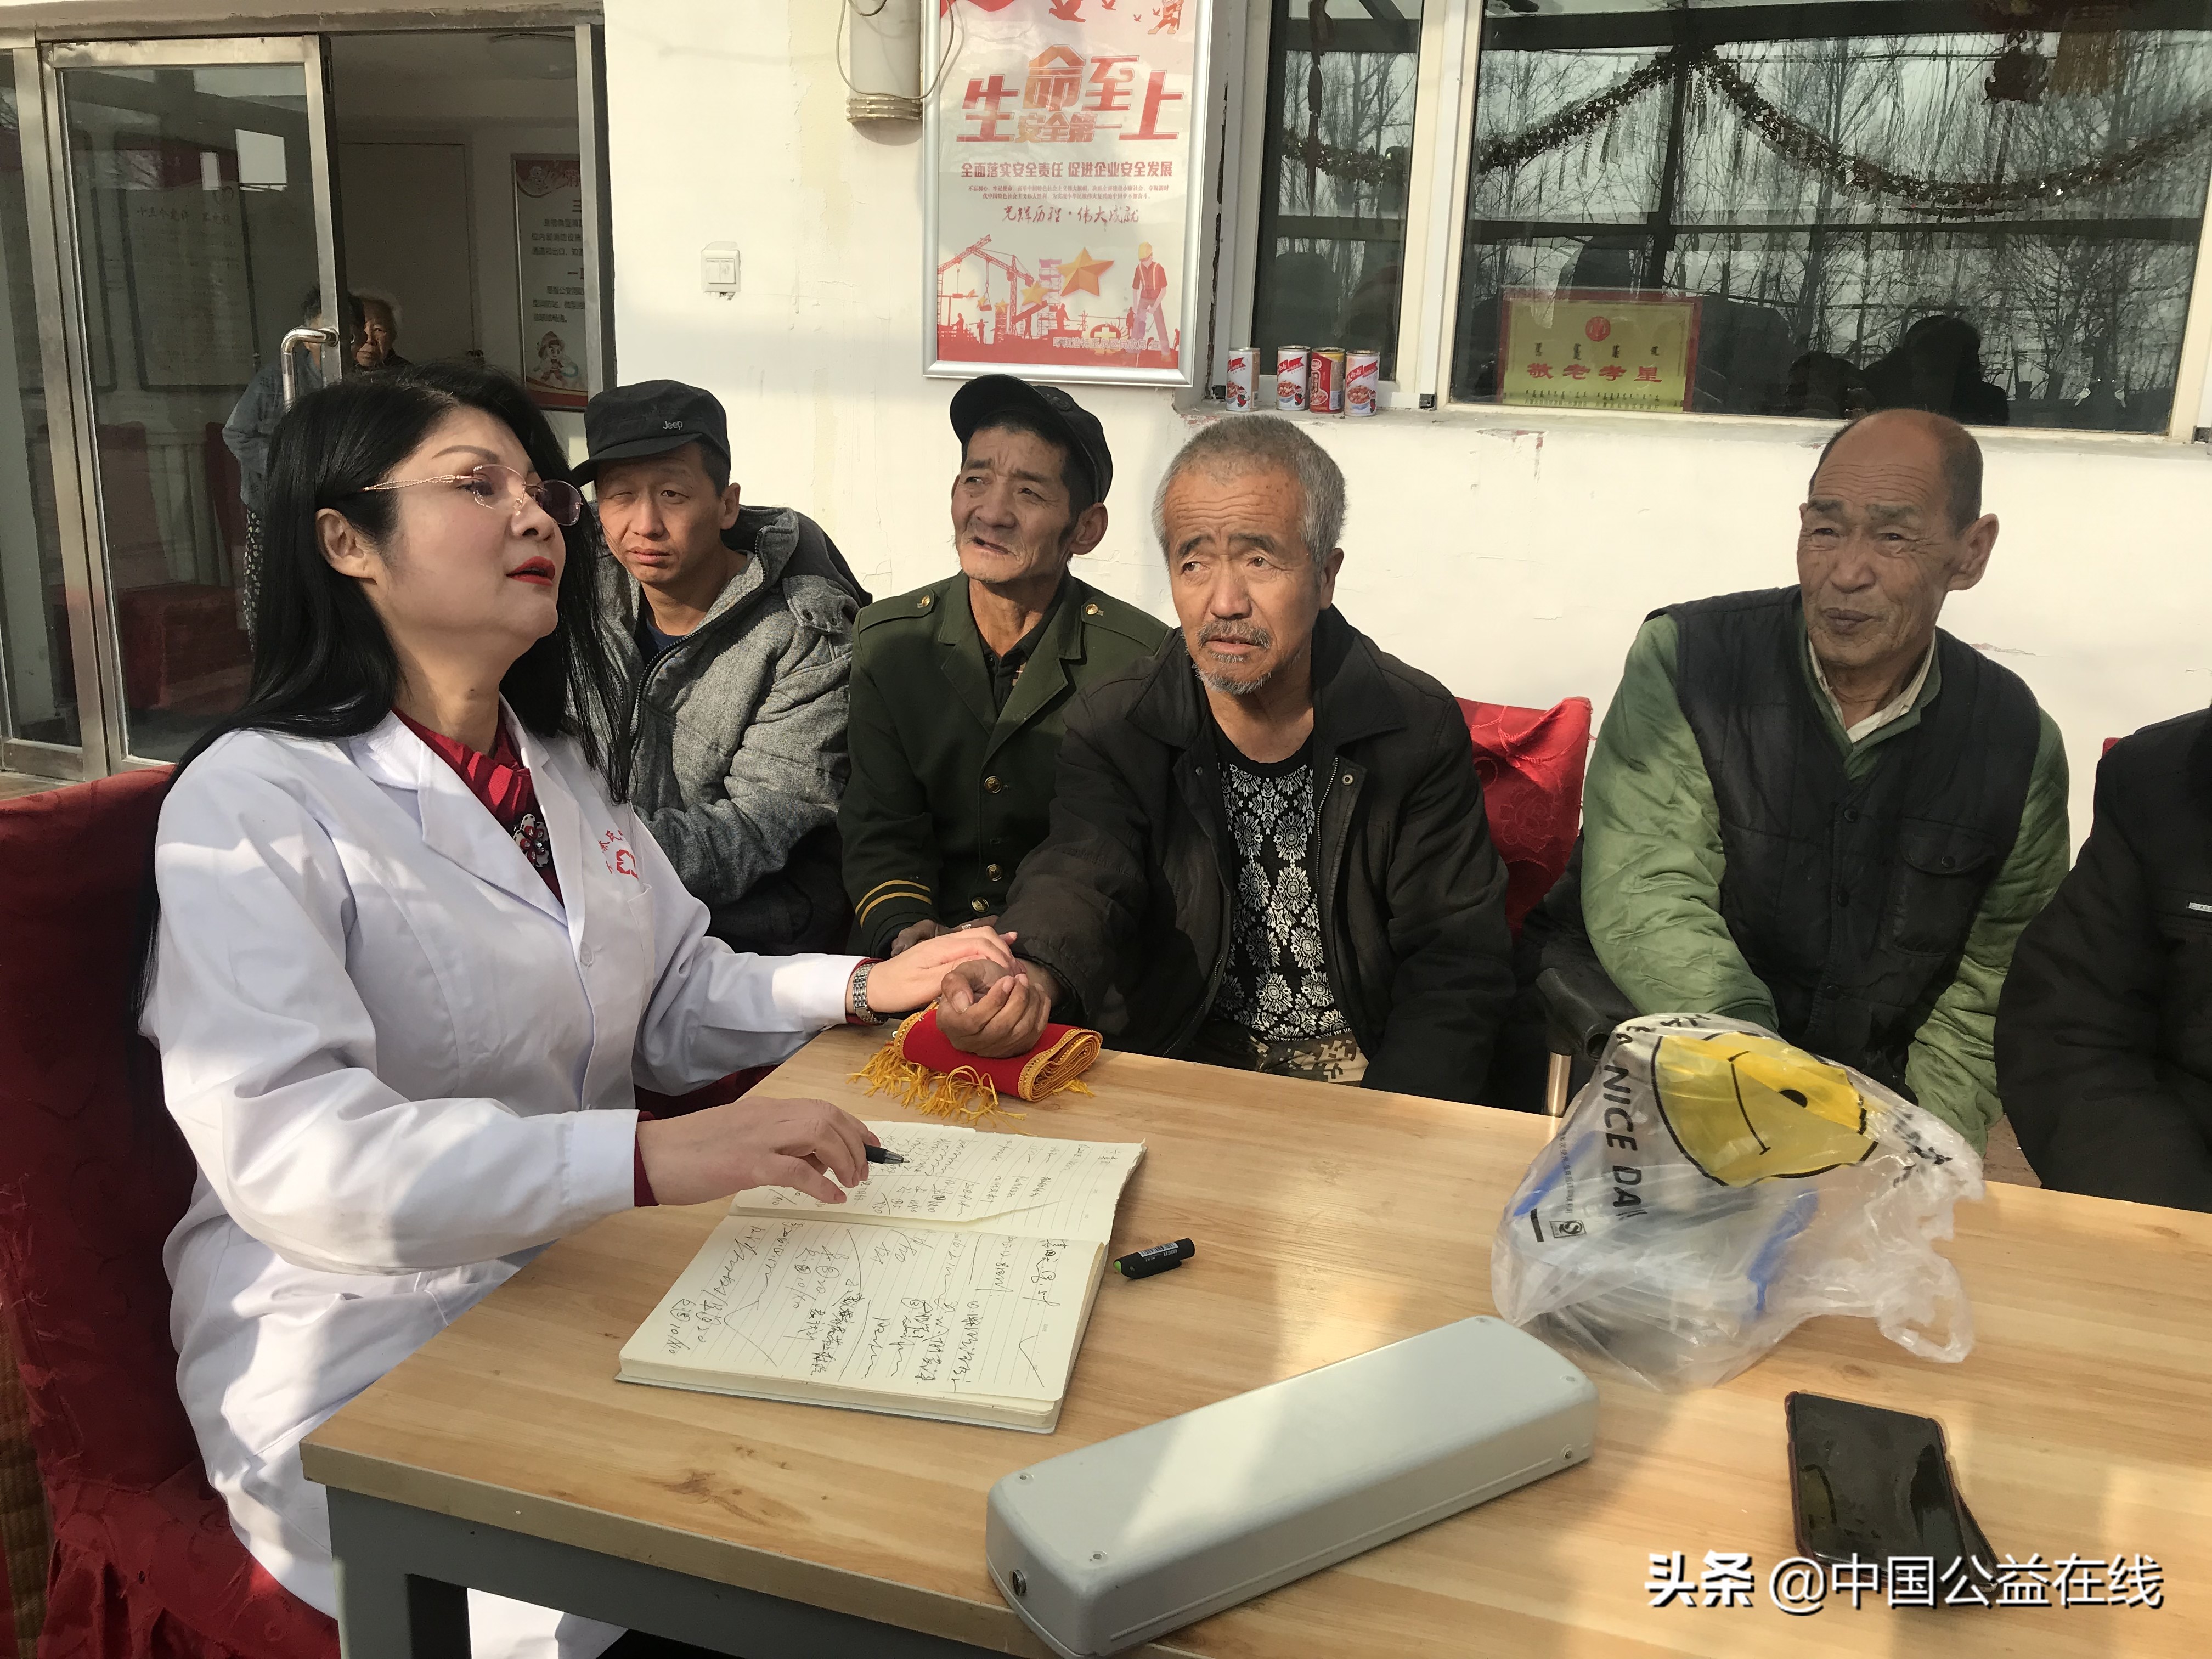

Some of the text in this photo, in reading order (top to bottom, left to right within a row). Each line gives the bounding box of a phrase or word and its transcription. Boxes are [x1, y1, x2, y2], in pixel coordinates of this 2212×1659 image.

[956, 44, 1187, 143] 生命至上
[1015, 112, 1122, 143] 安全第一
[961, 161, 1172, 177] 全面落实安全责任 促进企业安全发展
[1527, 363, 1662, 382] 敬老孝星
[663, 421, 683, 430] Jeep
[1603, 1065, 1638, 1151] NICE
